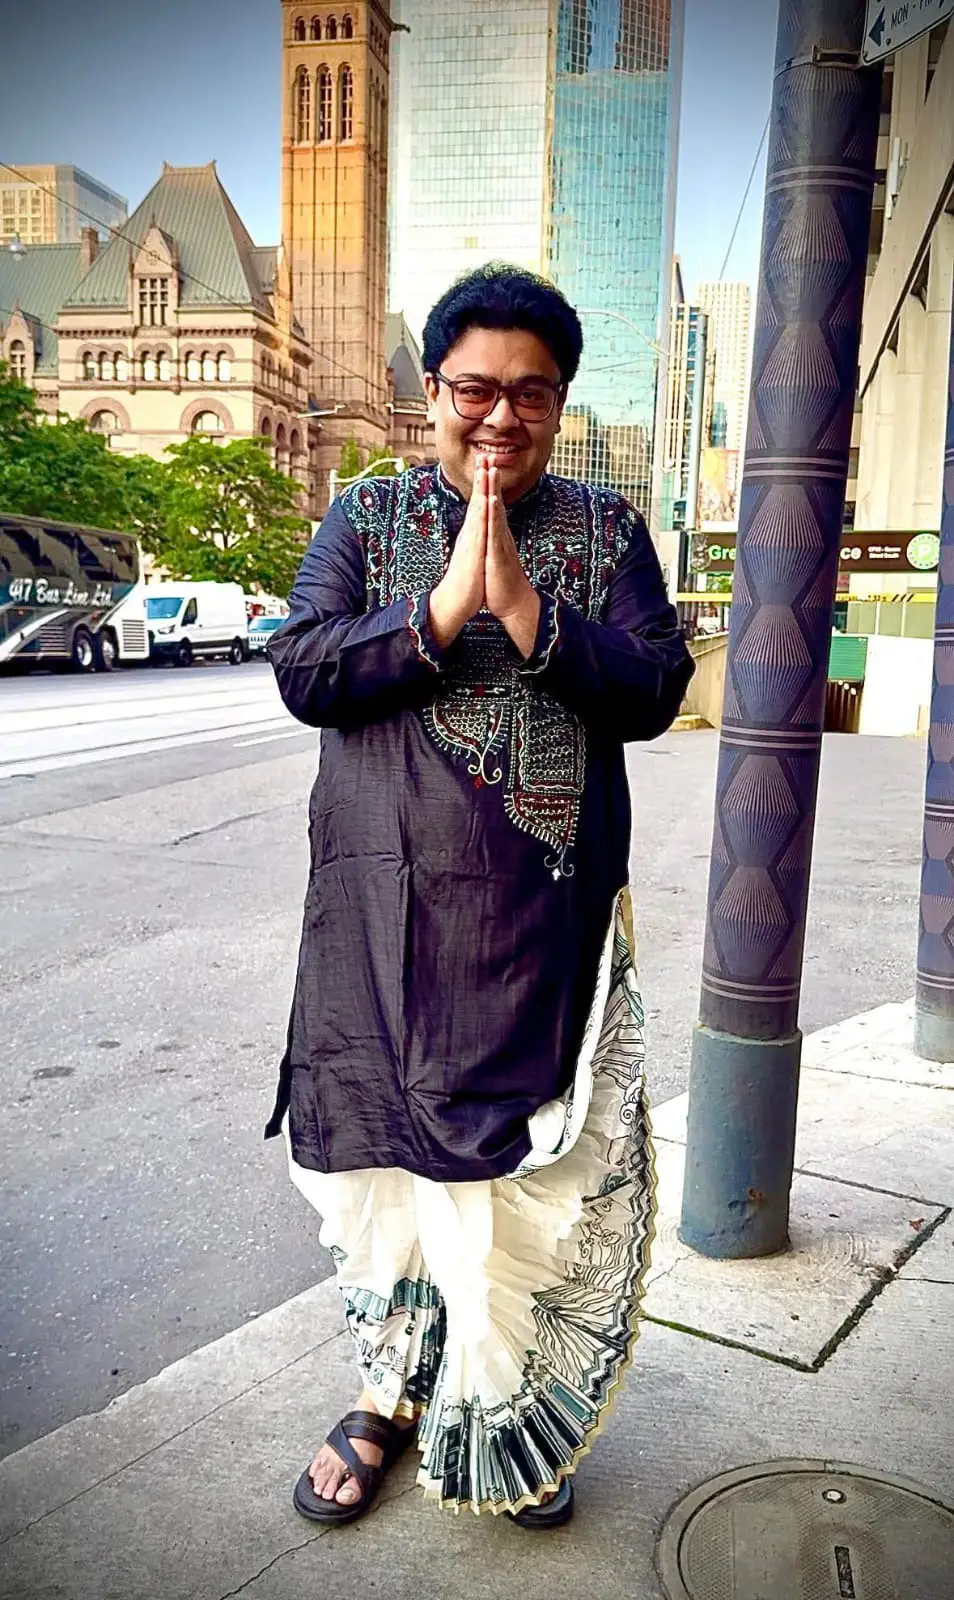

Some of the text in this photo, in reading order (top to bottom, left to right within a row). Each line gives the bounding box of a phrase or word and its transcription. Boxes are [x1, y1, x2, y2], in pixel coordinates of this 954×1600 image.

[890, 3, 909, 30] MON
[9, 577, 33, 603] 417
[36, 577, 60, 604] Bus
[63, 580, 89, 605] Line
